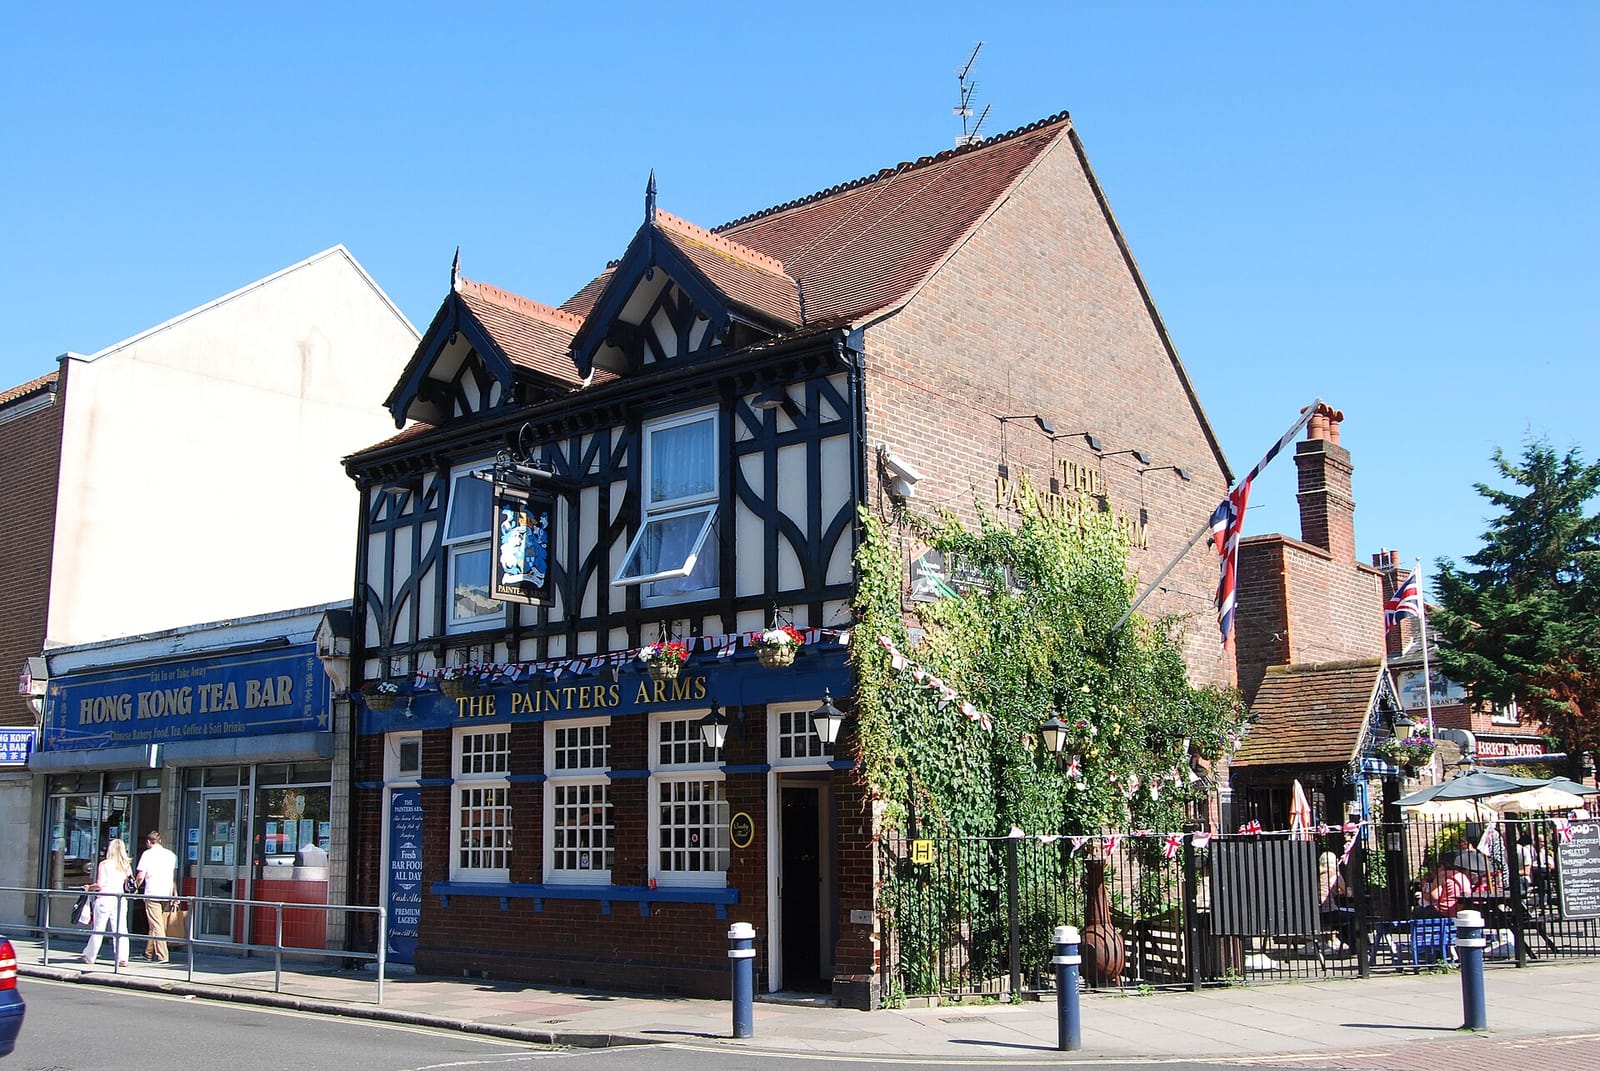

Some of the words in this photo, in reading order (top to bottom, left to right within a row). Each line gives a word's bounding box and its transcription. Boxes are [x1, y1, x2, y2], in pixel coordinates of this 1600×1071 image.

[1059, 458, 1100, 498] THE
[150, 671, 161, 682] Eat
[161, 671, 168, 681] In
[168, 671, 175, 680] or
[176, 668, 190, 680] Take
[191, 667, 207, 678] Away
[79, 693, 132, 725] HONG
[138, 685, 194, 720] KONG
[198, 681, 240, 715] TEA
[245, 675, 294, 710] BAR
[456, 695, 496, 718] THE
[510, 684, 620, 715] PAINTERS
[635, 676, 707, 705] ARMS
[209, 722, 222, 735] Soft
[223, 721, 246, 734] Drinks
[9, 743, 26, 752] BAR
[401, 850, 416, 859] Fresh
[916, 842, 929, 861] H
[392, 861, 405, 870] BAR
[395, 872, 408, 881] ALL
[408, 872, 422, 881] DAY
[395, 908, 420, 916] PREMIUM
[397, 916, 418, 924] LAGERS
